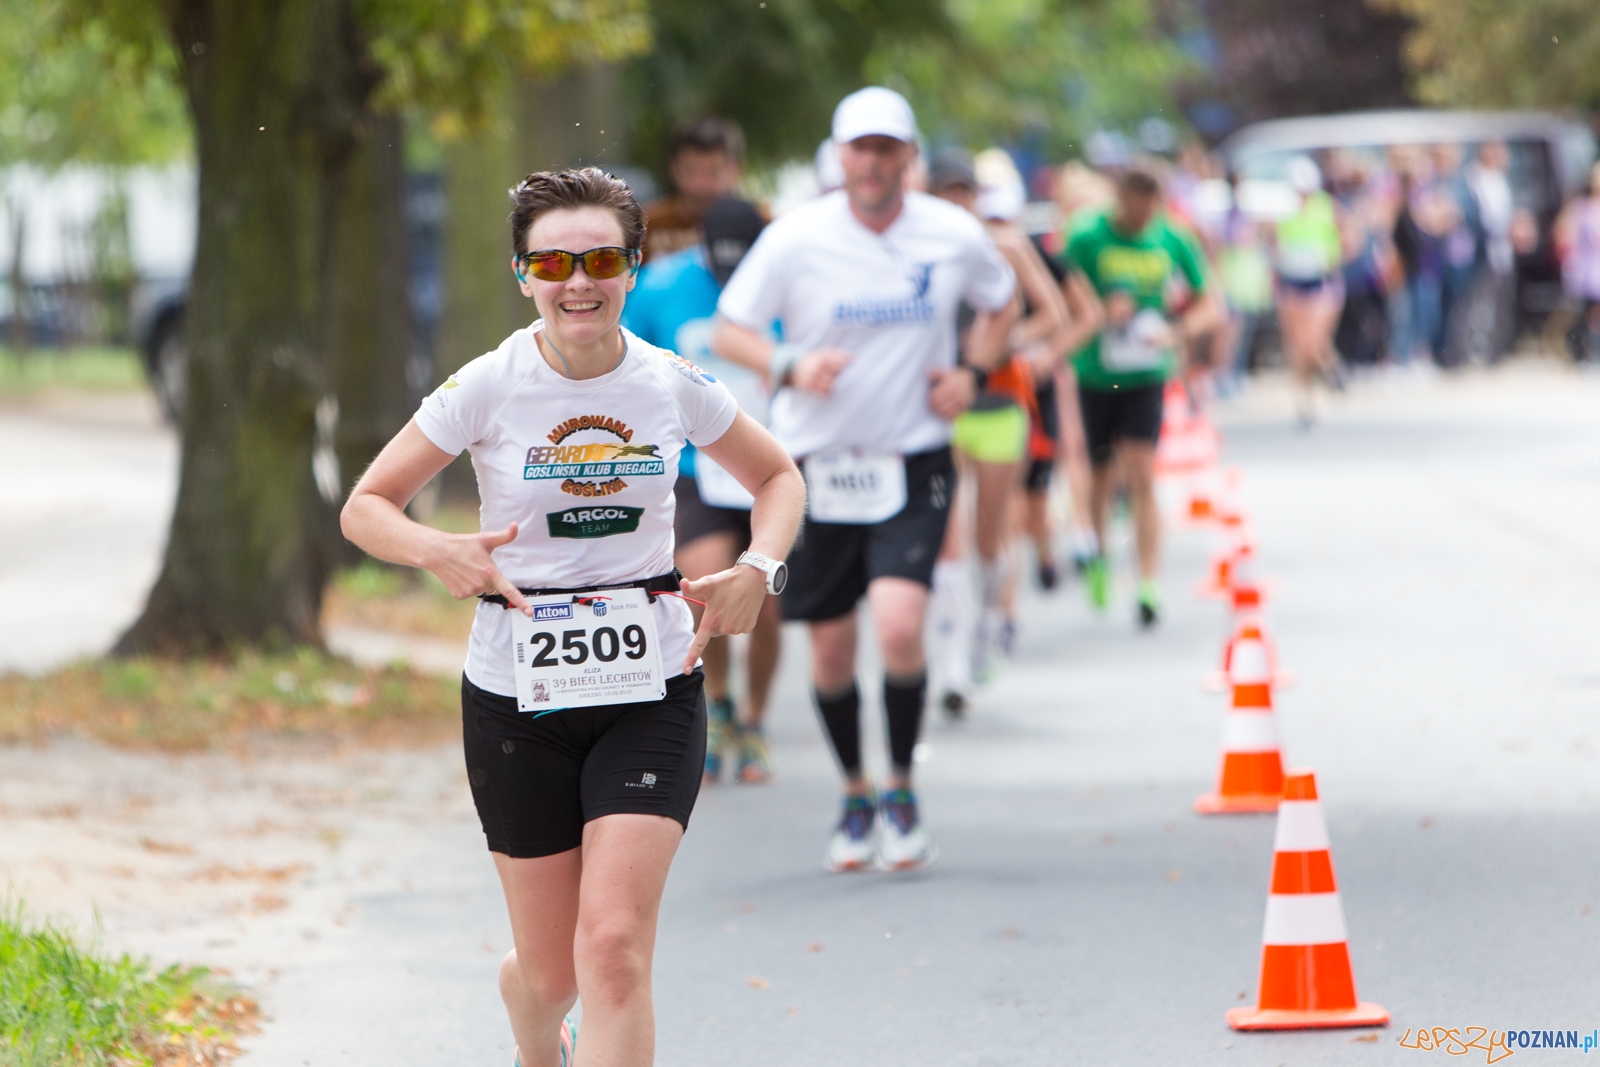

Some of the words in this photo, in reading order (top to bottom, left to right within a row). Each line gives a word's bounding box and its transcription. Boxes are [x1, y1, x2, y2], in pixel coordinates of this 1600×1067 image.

[547, 415, 634, 445] MUROWANA
[525, 444, 592, 465] GEPARD
[525, 464, 580, 479] GOŚLIŃSKI
[583, 463, 611, 476] KLUB
[613, 462, 664, 475] BIEGACZA
[560, 477, 629, 497] GOŚLINA
[562, 508, 628, 524] ARGOL
[581, 524, 610, 533] TEAM
[611, 604, 627, 612] Bank
[530, 624, 647, 668] 2509
[552, 678, 566, 689] 39
[569, 676, 596, 687] BIEG
[599, 669, 652, 684] LECHITÓW
[584, 667, 601, 675] ELIZA
